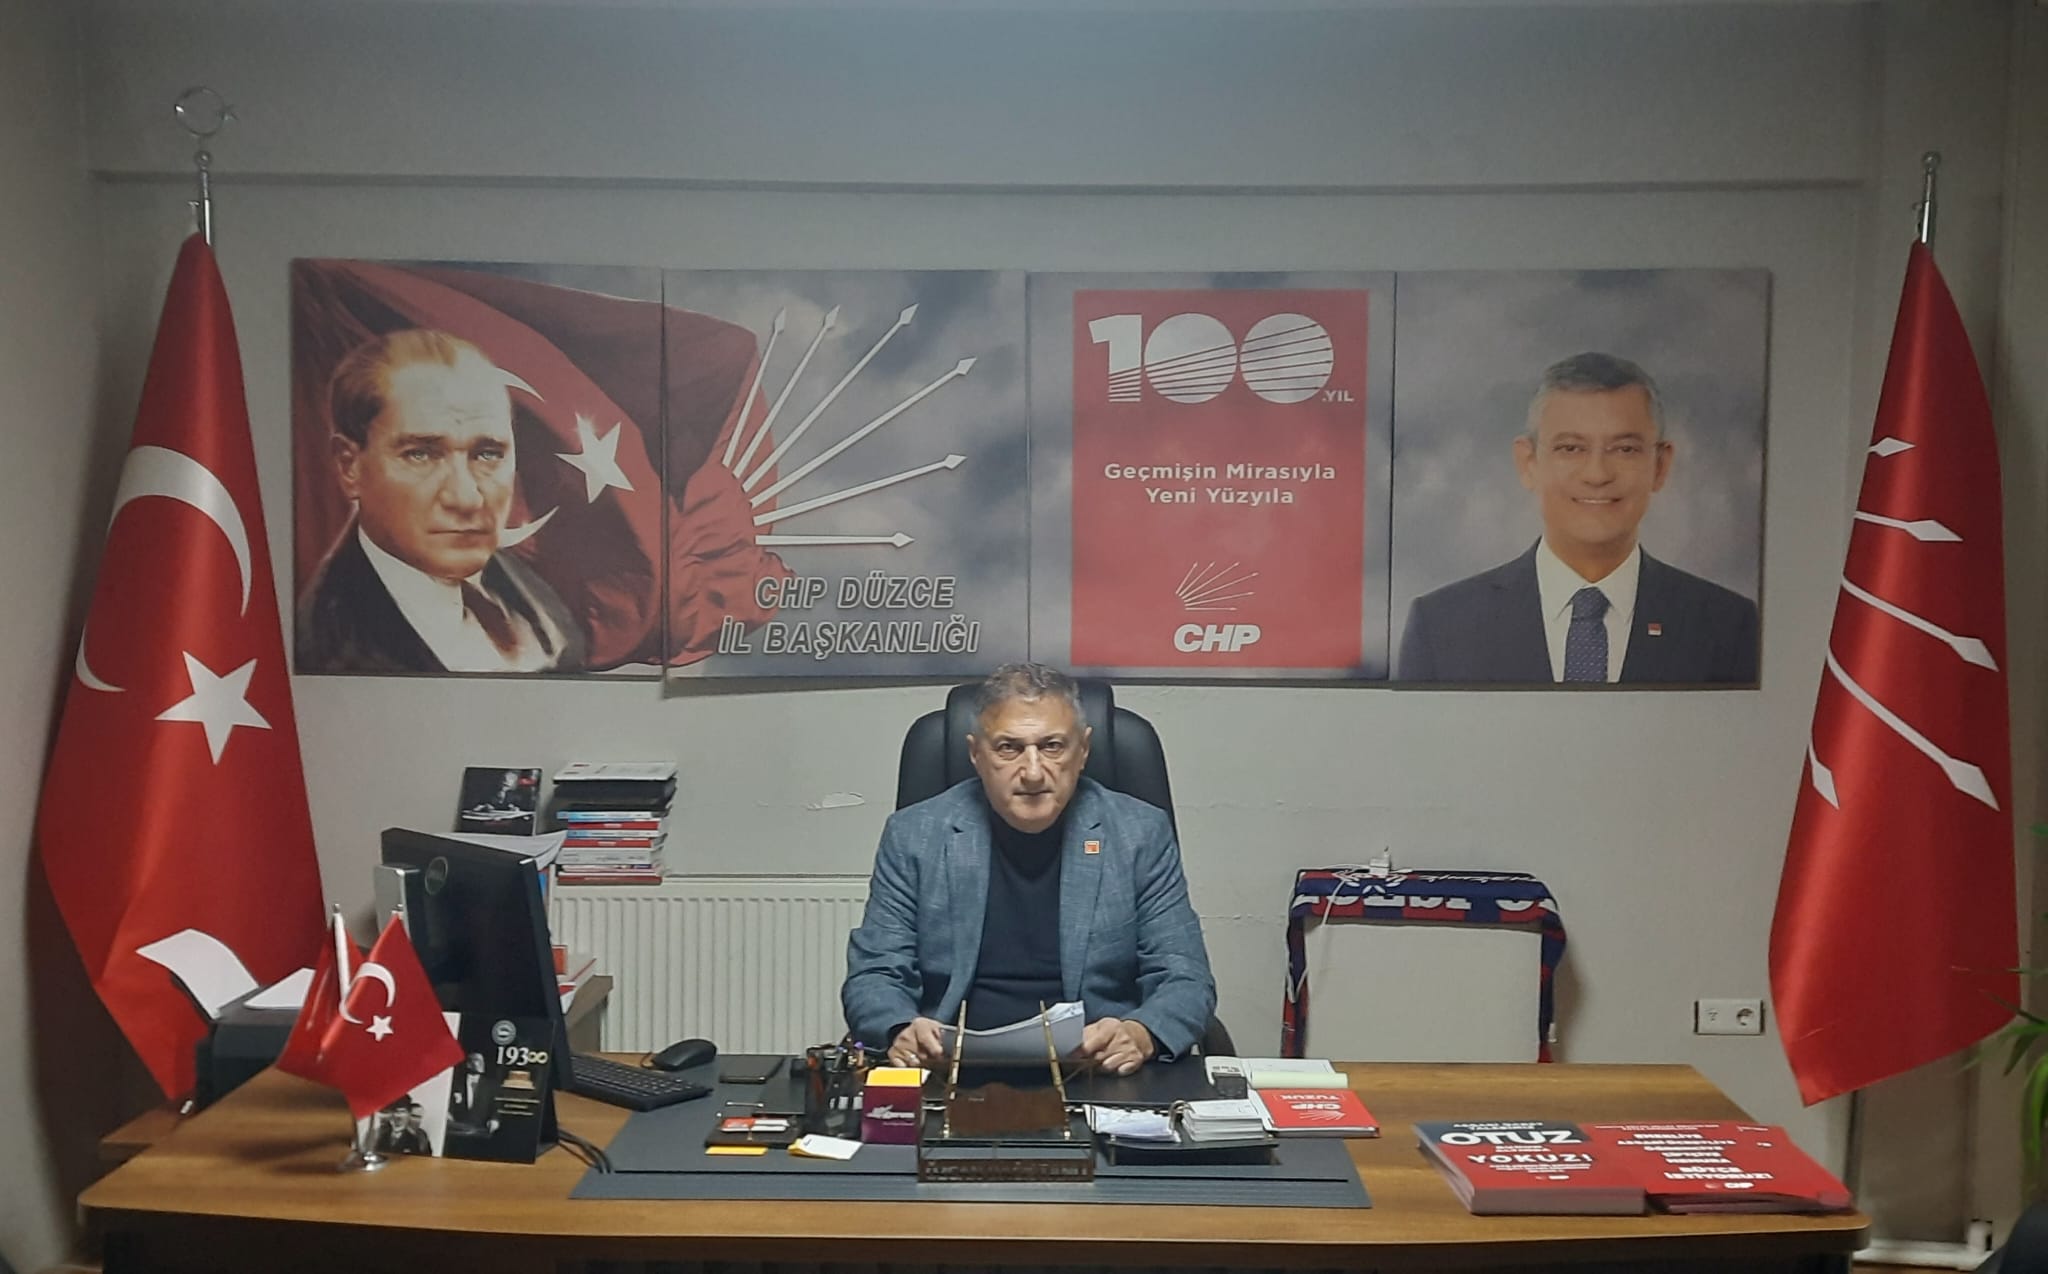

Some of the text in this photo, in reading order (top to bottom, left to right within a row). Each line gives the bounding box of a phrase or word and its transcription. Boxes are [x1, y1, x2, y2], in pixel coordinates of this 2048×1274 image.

[1088, 313, 1334, 404] 100
[1104, 463, 1336, 482] Geçmişin Mirasıyla
[1145, 487, 1294, 506] Yeni Yüzyıla
[755, 571, 955, 609] CHP DÜZCE
[718, 615, 980, 660] İL BAŞKANLIĞI
[1173, 623, 1261, 652] CHP
[1440, 1130, 1583, 1145] OTUZ
[1467, 1153, 1593, 1164] YOKUZ!
